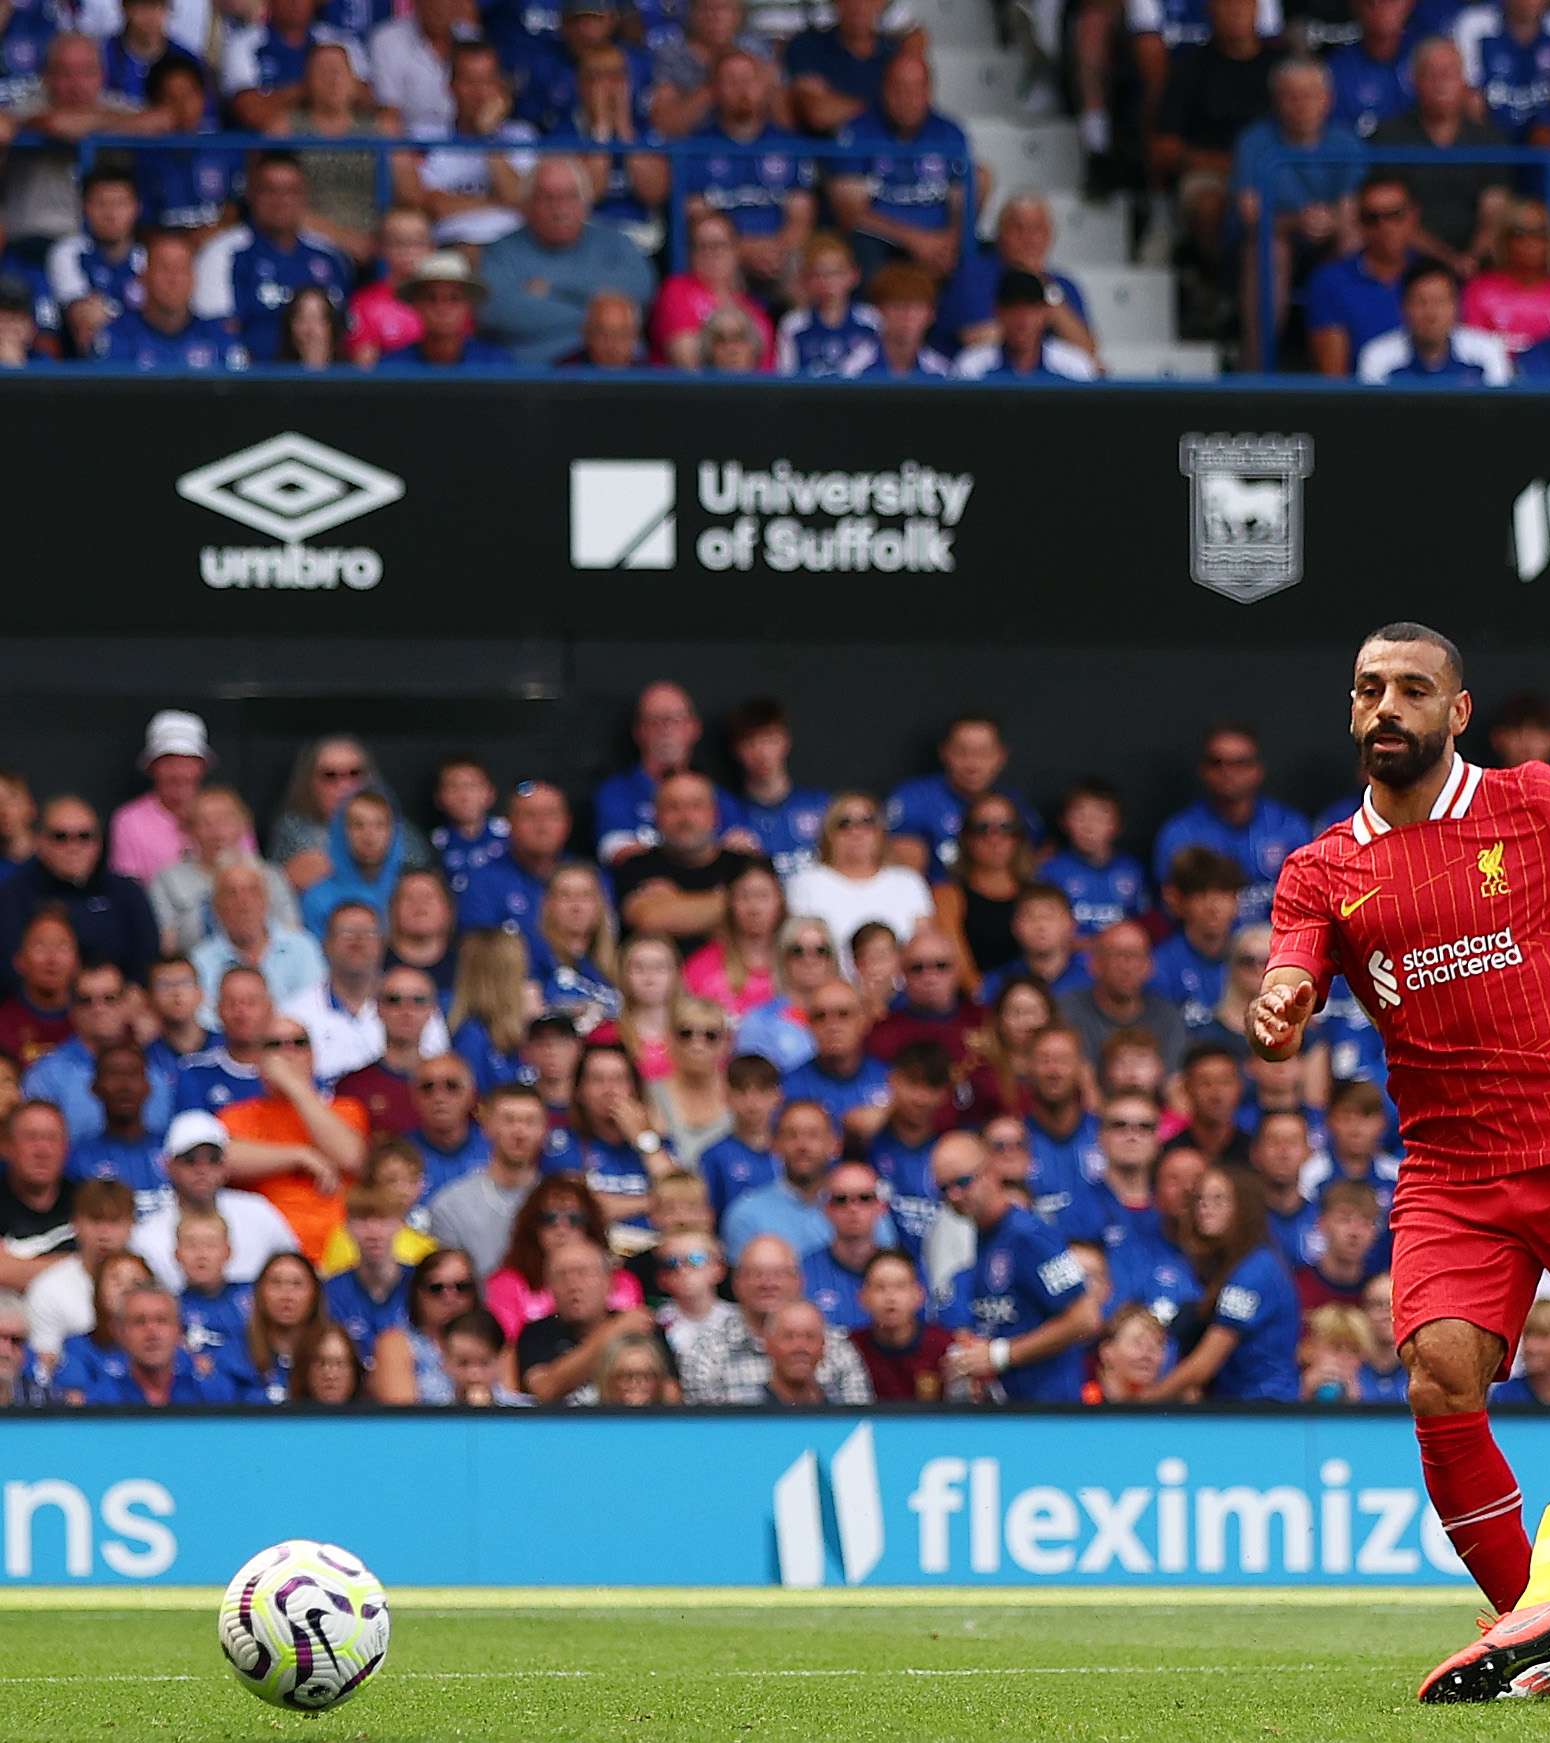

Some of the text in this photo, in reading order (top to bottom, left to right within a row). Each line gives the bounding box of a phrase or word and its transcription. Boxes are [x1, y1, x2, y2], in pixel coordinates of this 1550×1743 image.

[698, 462, 973, 521] University
[201, 544, 383, 590] umbro
[697, 520, 957, 572] of Suffolk
[1402, 927, 1514, 972] standard
[1404, 946, 1523, 992] chartered
[3, 1477, 178, 1578] ns
